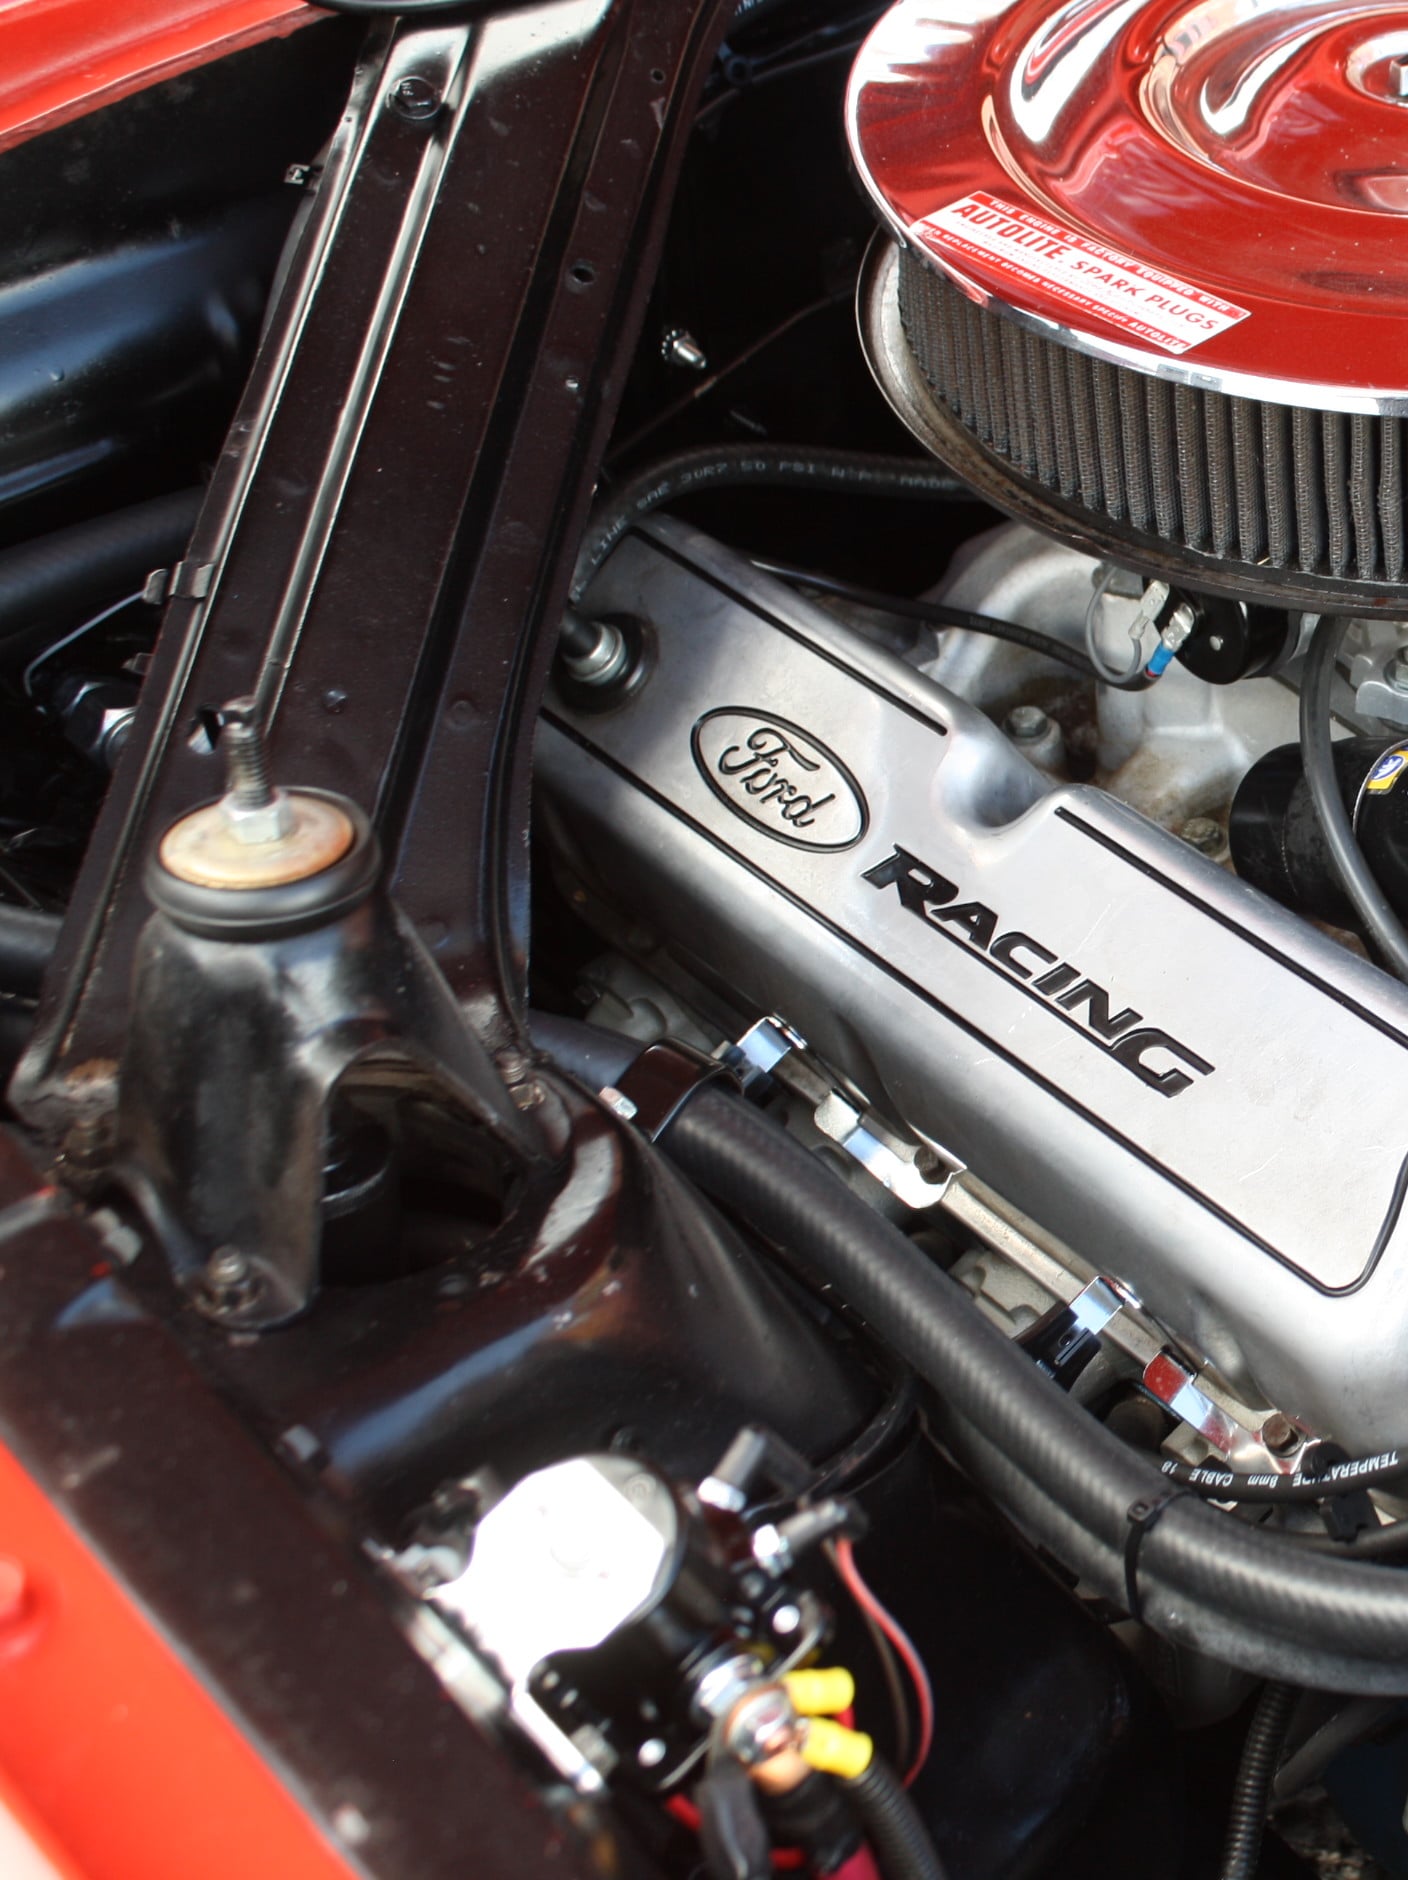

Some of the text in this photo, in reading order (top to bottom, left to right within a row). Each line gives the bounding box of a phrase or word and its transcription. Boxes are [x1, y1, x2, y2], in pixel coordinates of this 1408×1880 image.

[942, 233, 1000, 263] REPLACEMENT
[989, 199, 1231, 312] THIS ENGINE IS FACTORY EQUIPPED WITH
[1070, 260, 1147, 297] SPARK
[1144, 294, 1220, 330] PLUGS
[718, 727, 836, 828] Ford
[860, 843, 1215, 1098] RACING
[1160, 1460, 1178, 1474] 18
[1189, 1468, 1234, 1487] CABLE
[1247, 1474, 1280, 1488] 8mm
